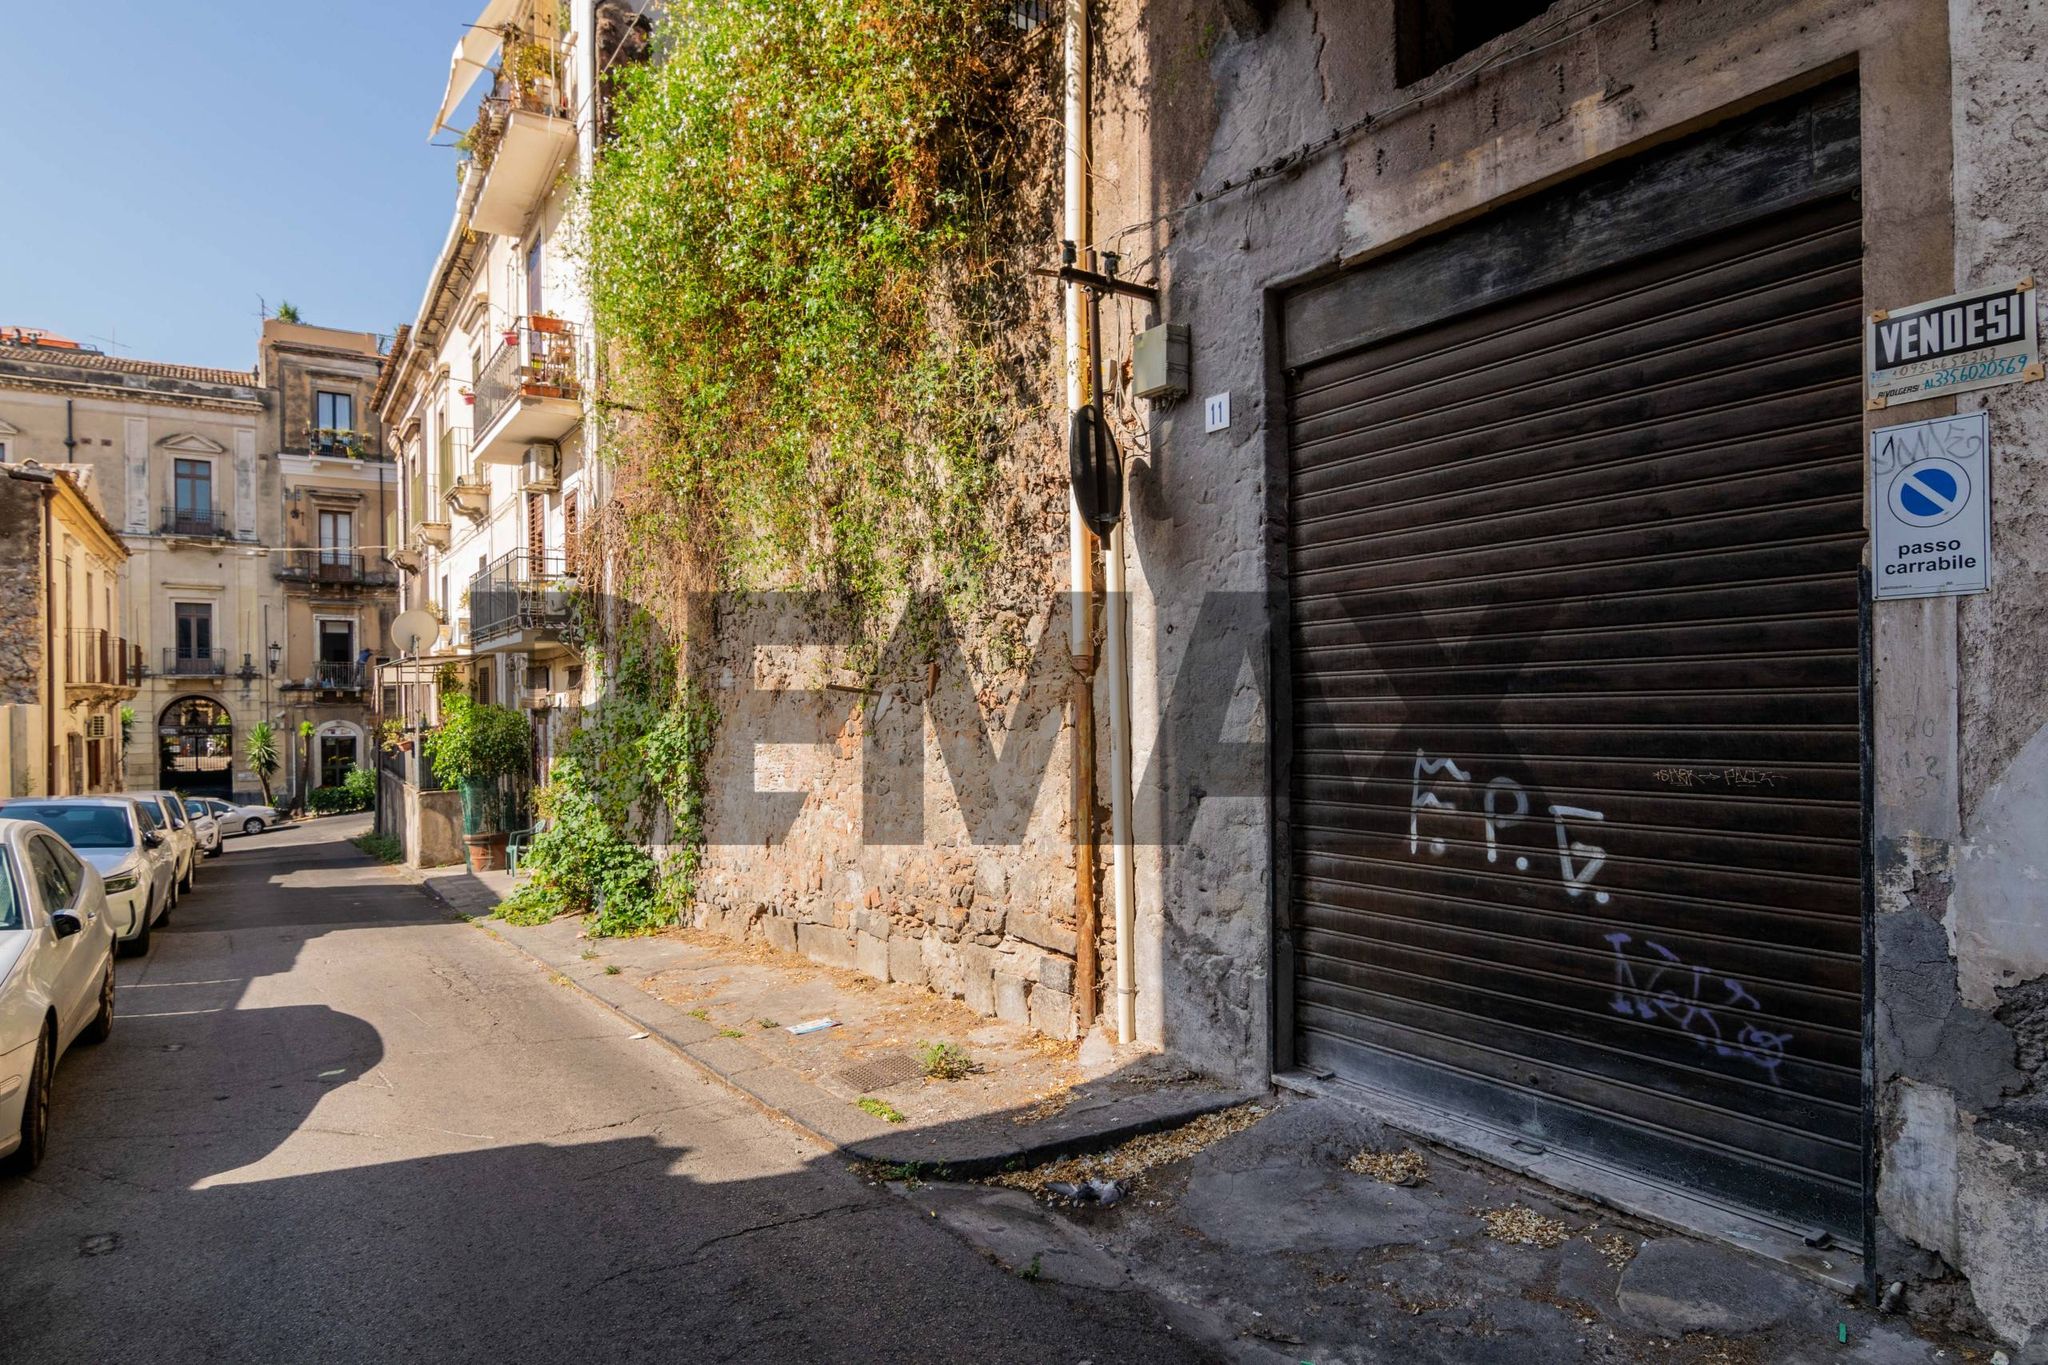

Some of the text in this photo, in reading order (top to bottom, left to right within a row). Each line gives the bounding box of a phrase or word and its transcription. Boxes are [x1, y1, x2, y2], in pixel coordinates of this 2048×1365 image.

[1880, 294, 2020, 363] VENDESI
[1211, 401, 1223, 425] 11
[1899, 540, 1961, 559] passo
[1885, 554, 1977, 575] carrabile
